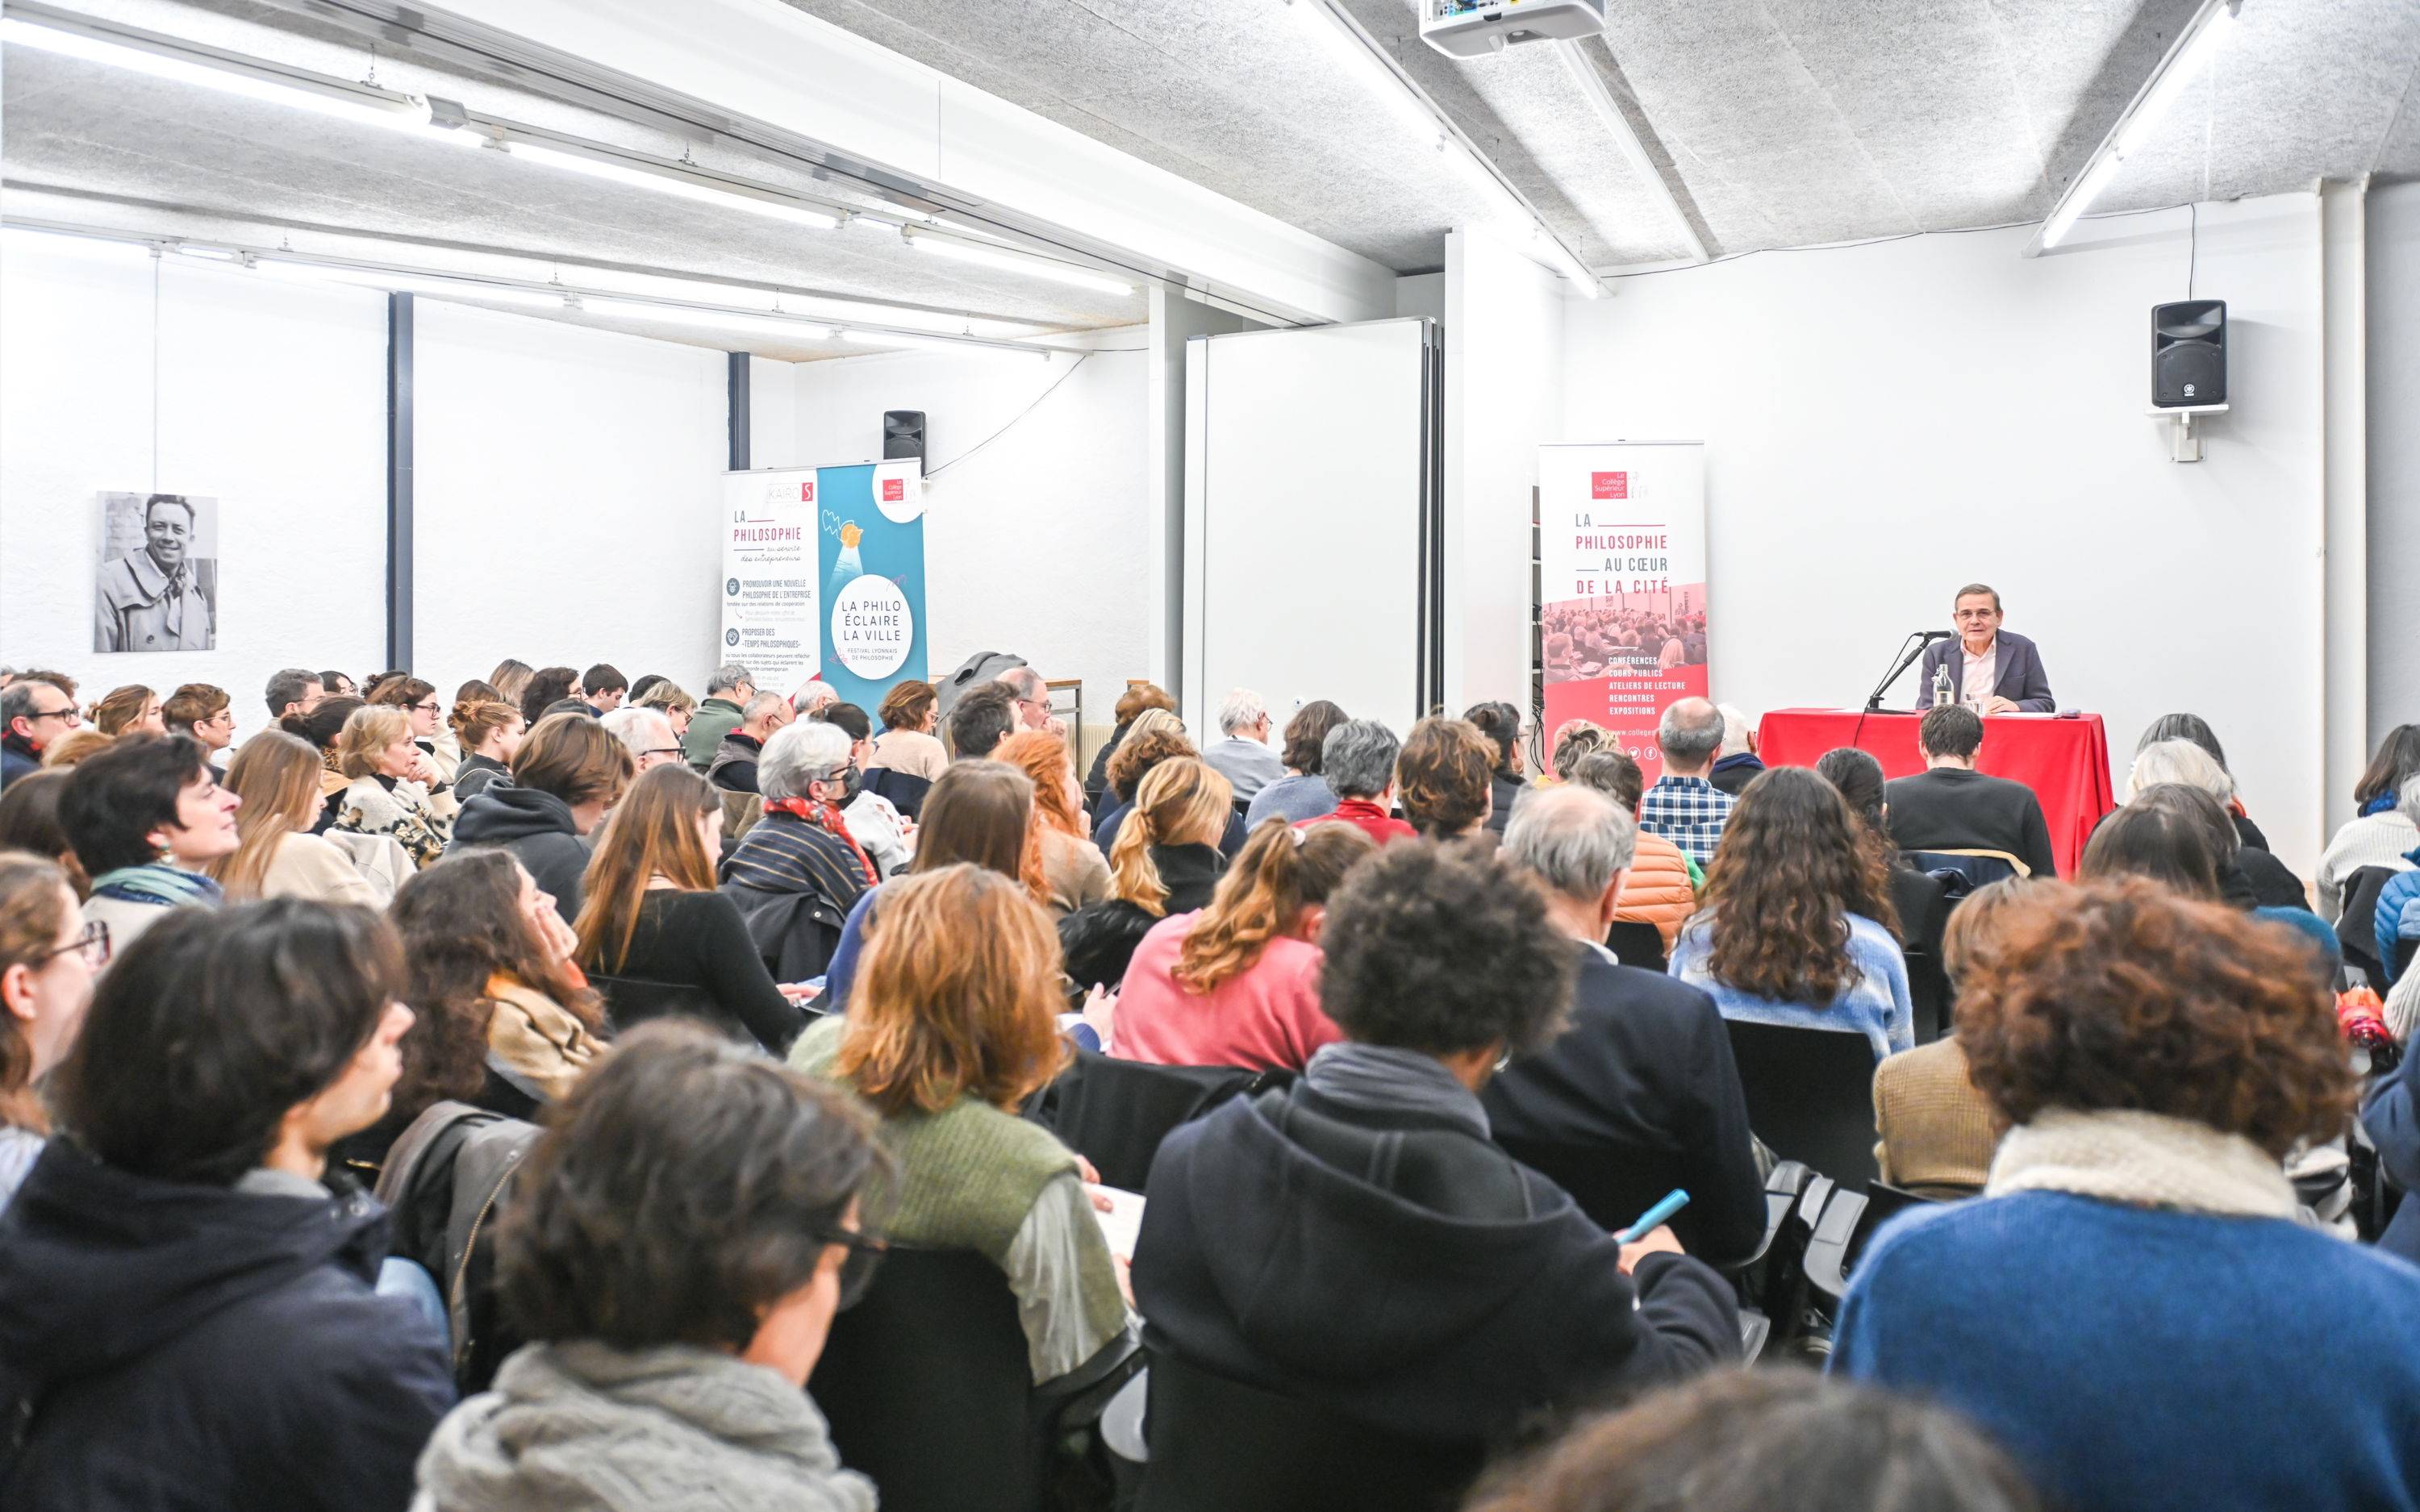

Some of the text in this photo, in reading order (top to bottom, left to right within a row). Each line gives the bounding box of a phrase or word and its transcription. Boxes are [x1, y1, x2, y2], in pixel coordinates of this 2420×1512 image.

[1601, 478, 1625, 486] Collège
[734, 510, 745, 523] LA
[1575, 514, 1592, 527] LA
[733, 527, 801, 541] PHILOSOPHIE
[1575, 535, 1667, 550] PHILOSOPHIE
[1604, 557, 1668, 572] AU CŒUR
[742, 579, 807, 588] PROMOUVOIR UNE NOUVELLE
[1576, 577, 1668, 594] DE LA CITÉ
[742, 590, 771, 599] PHILOSOPHIE
[772, 590, 779, 598] DE
[841, 600, 901, 612] LA PHILO
[845, 613, 899, 627] ÉCLAIRE
[741, 628, 765, 636] PROPOSER
[844, 630, 901, 641] LA VILLE
[1608, 655, 1658, 665] CONFÉRENCES
[1608, 669, 1663, 677] COURS PUBLICS
[1608, 681, 1686, 689] ATELIERS DE LECTURE
[1608, 694, 1655, 702] RENCONTRES
[1609, 706, 1656, 715] EXPOSITIONS
